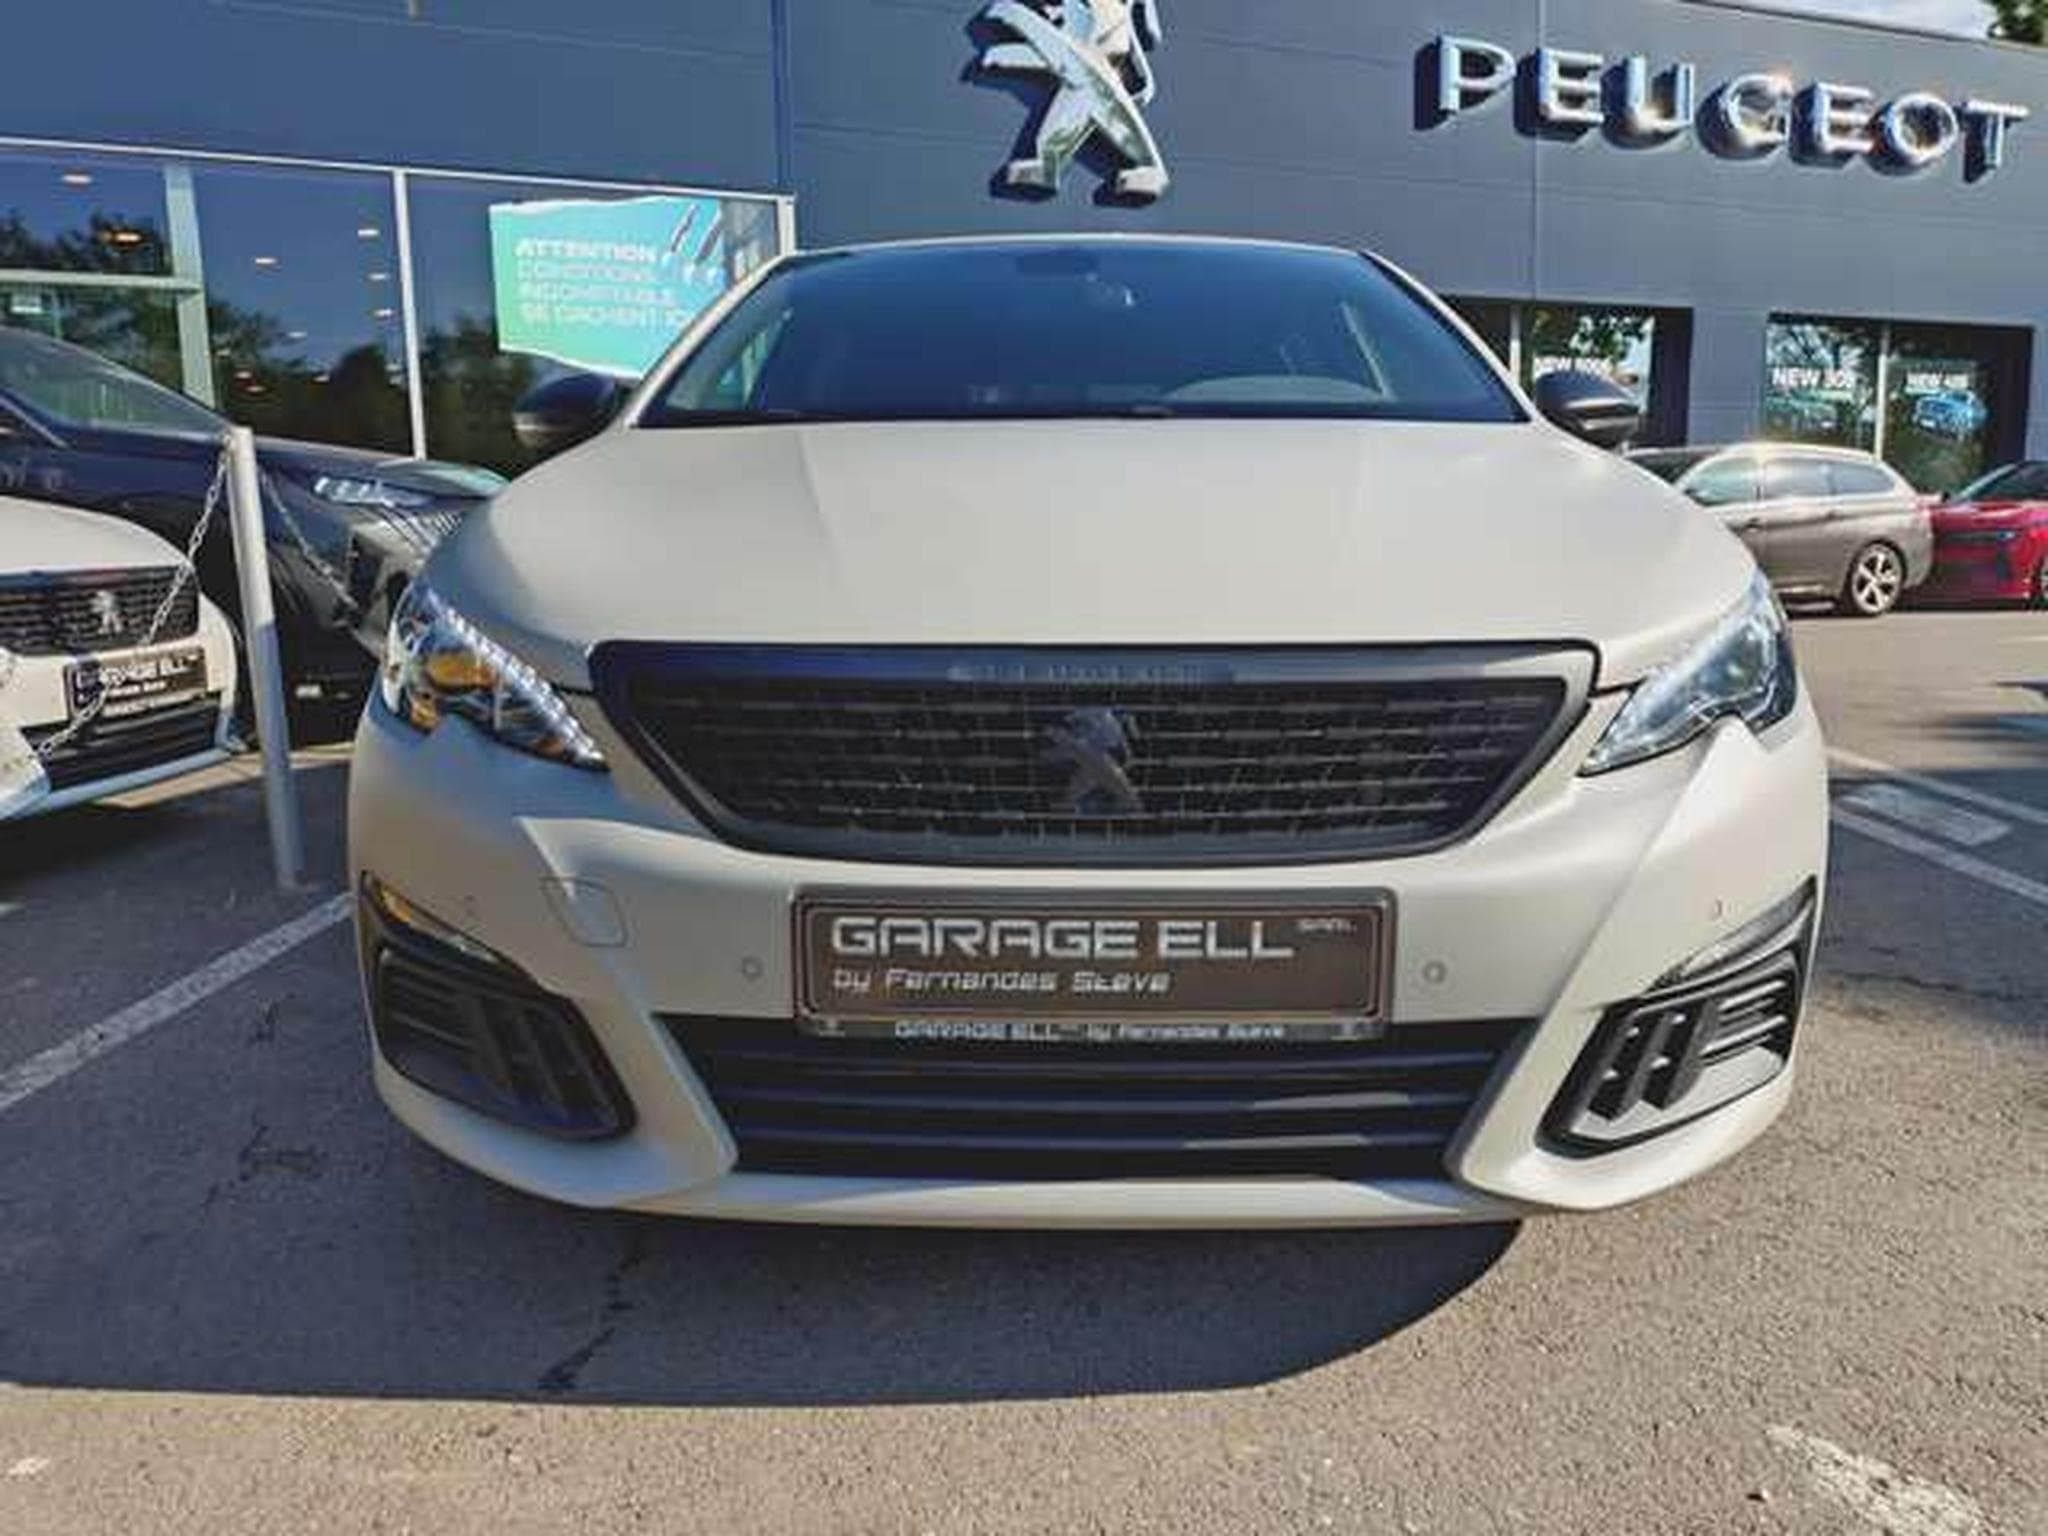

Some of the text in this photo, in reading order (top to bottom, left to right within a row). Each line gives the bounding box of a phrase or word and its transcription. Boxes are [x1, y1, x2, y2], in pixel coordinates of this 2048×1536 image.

[1430, 34, 2030, 178] PEUGEOT
[514, 238, 658, 264] ATTENTION
[1772, 366, 1821, 387] NEW
[1907, 371, 1943, 387] NEW
[831, 916, 1138, 960] GARAGE
[1158, 919, 1295, 960] ELL
[833, 968, 1170, 994] by Fernandes Steve
[895, 1022, 1007, 1041] GARAGE
[1012, 1022, 1060, 1042] ELL
